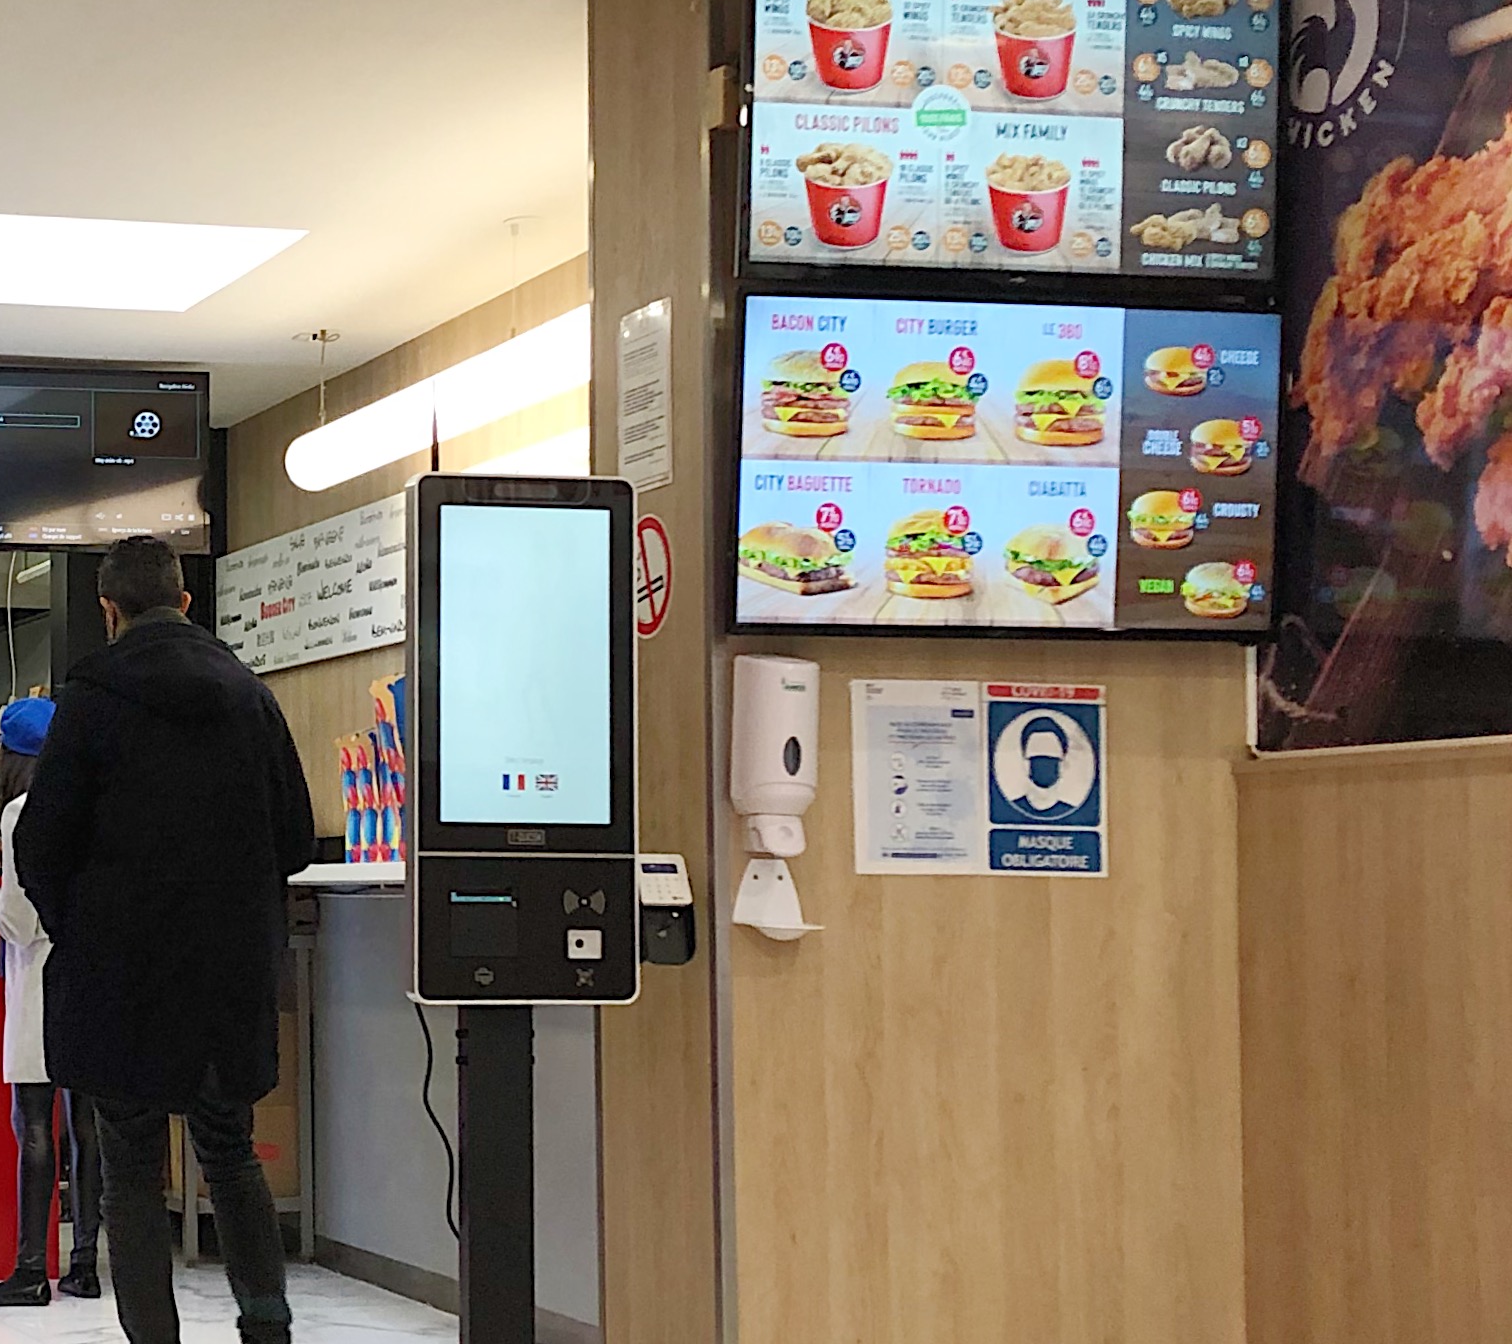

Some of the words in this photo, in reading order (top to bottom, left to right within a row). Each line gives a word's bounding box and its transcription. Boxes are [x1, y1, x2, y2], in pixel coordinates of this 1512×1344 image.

[794, 112, 850, 133] CLASSIC
[852, 116, 900, 135] PILONS
[995, 122, 1021, 139] MIX
[1023, 123, 1068, 142] FAMILY
[771, 313, 815, 331] BACON
[817, 315, 848, 333] CITY
[895, 317, 924, 334] CITY
[927, 318, 979, 336] BURGER
[1220, 349, 1260, 365] CHEESE
[1142, 440, 1184, 456] CHEESE
[754, 474, 784, 491] CITY
[787, 475, 854, 493] BAGUETTE
[902, 477, 963, 494] TORNADO
[1028, 480, 1087, 497] CIABATTA
[1017, 835, 1075, 851] MASQUE
[1000, 853, 1089, 870] OBLIGATOIRE
